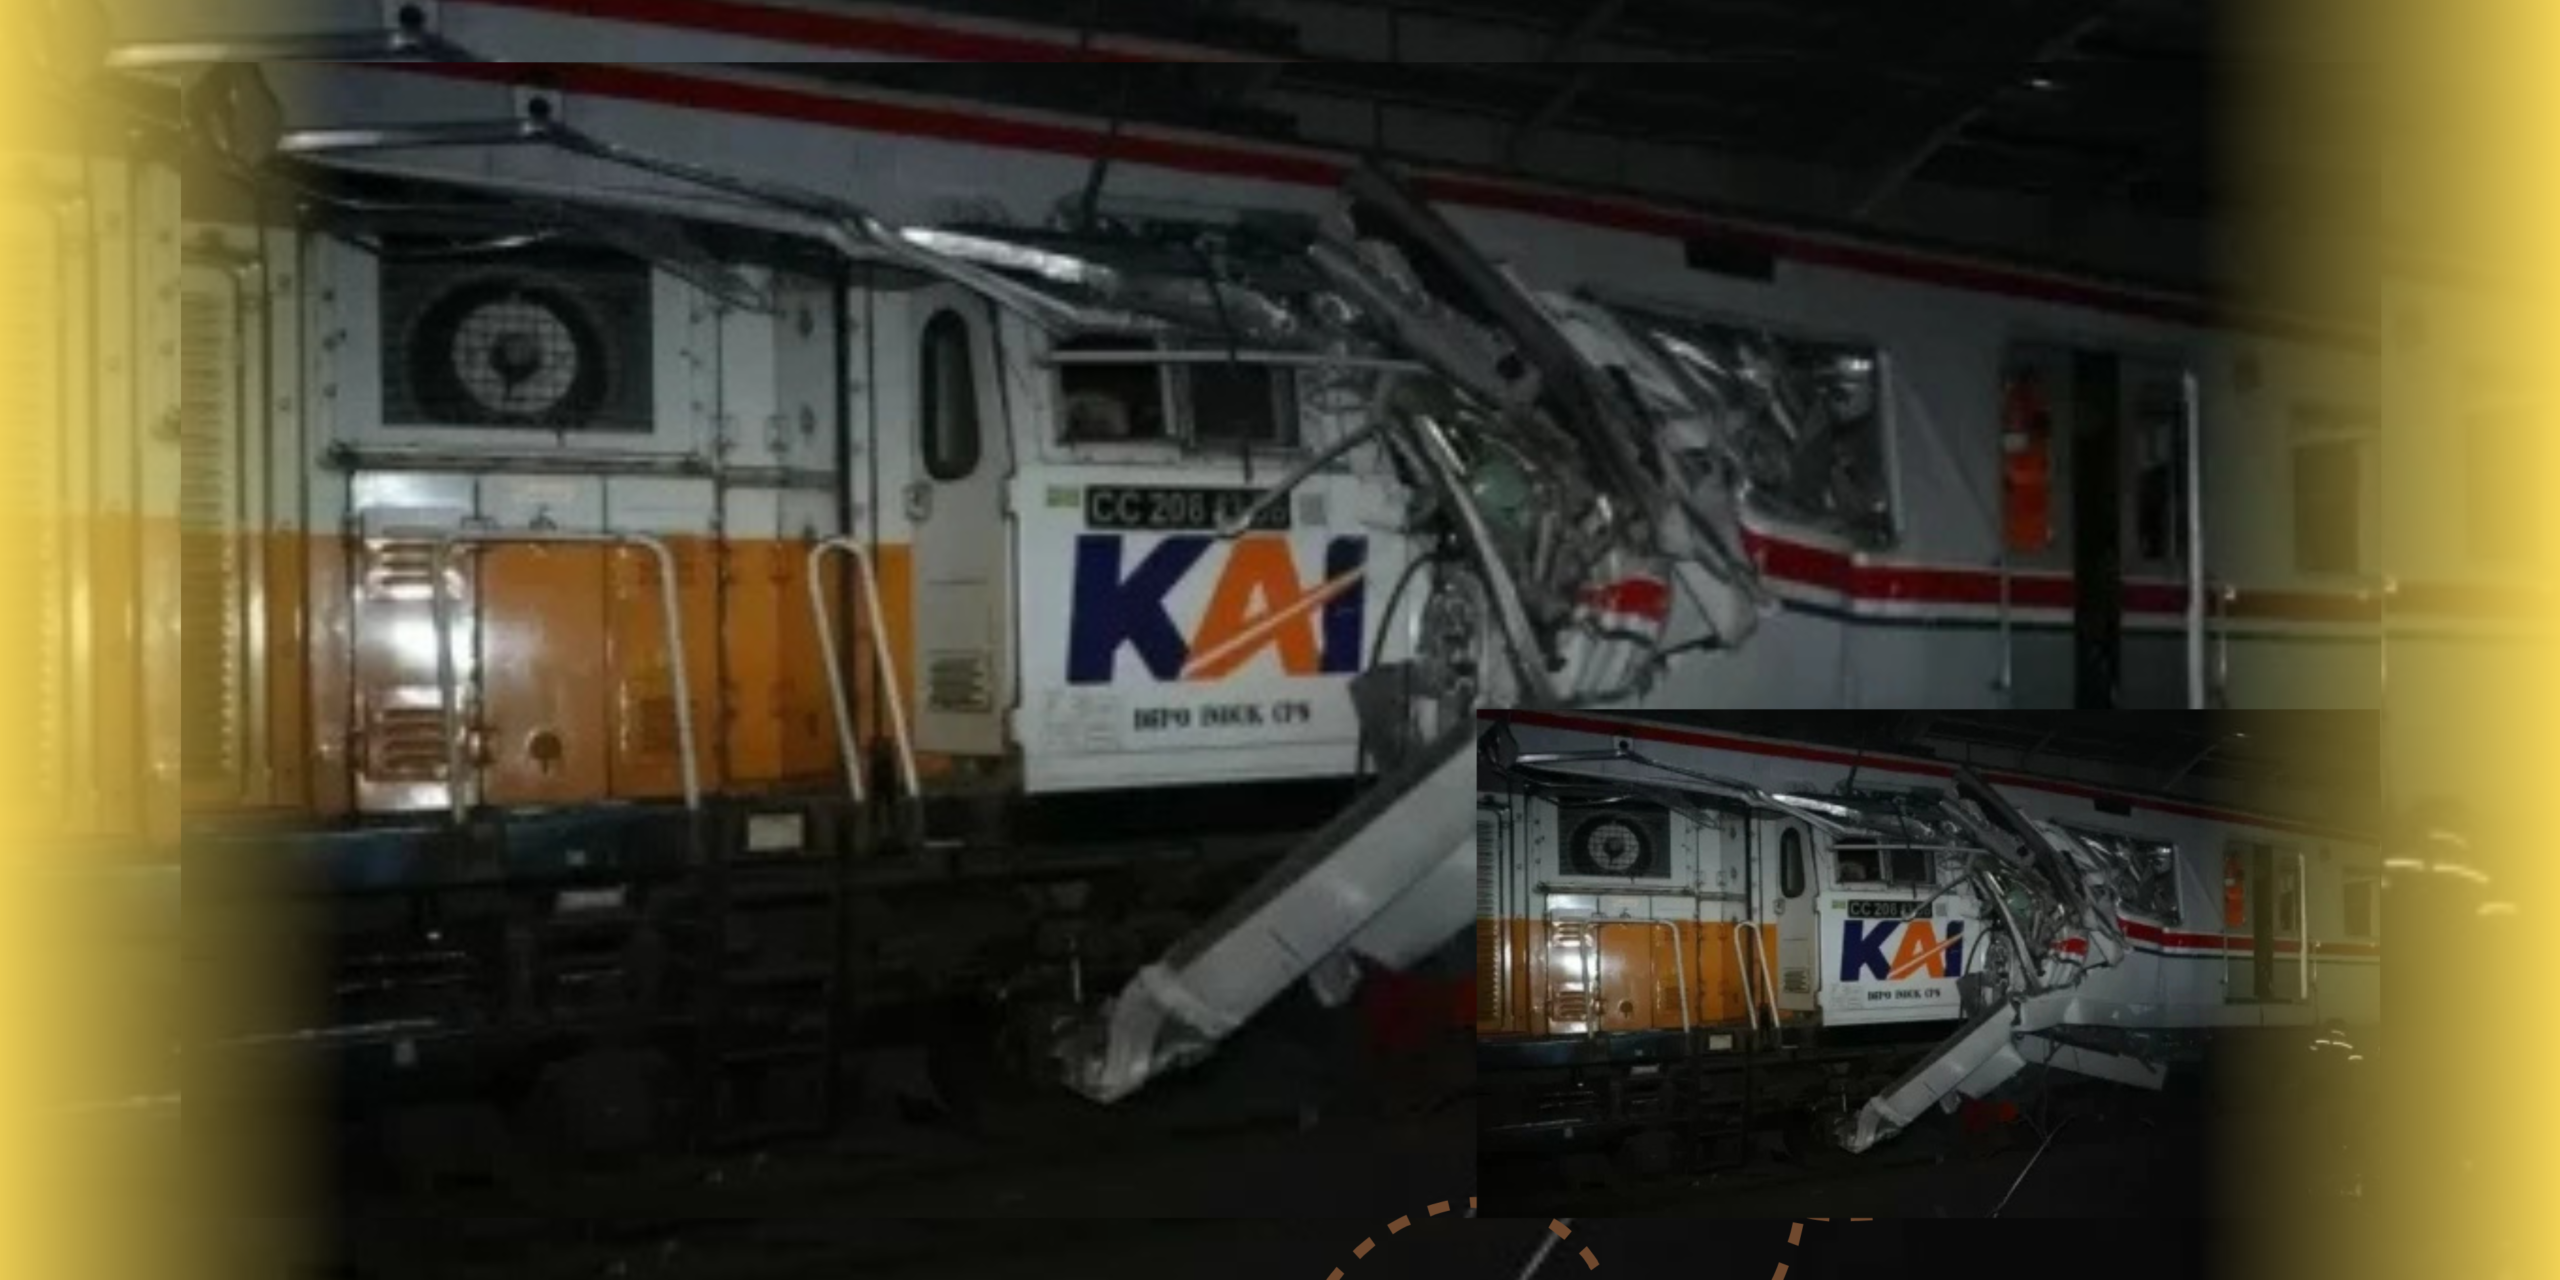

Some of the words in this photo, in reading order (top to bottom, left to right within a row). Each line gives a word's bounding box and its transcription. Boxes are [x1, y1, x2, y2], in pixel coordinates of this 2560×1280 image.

[1092, 491, 1141, 523] CC
[1065, 533, 1368, 686] KAI
[1850, 902, 1871, 916] CC
[1840, 919, 1964, 982] KAI
